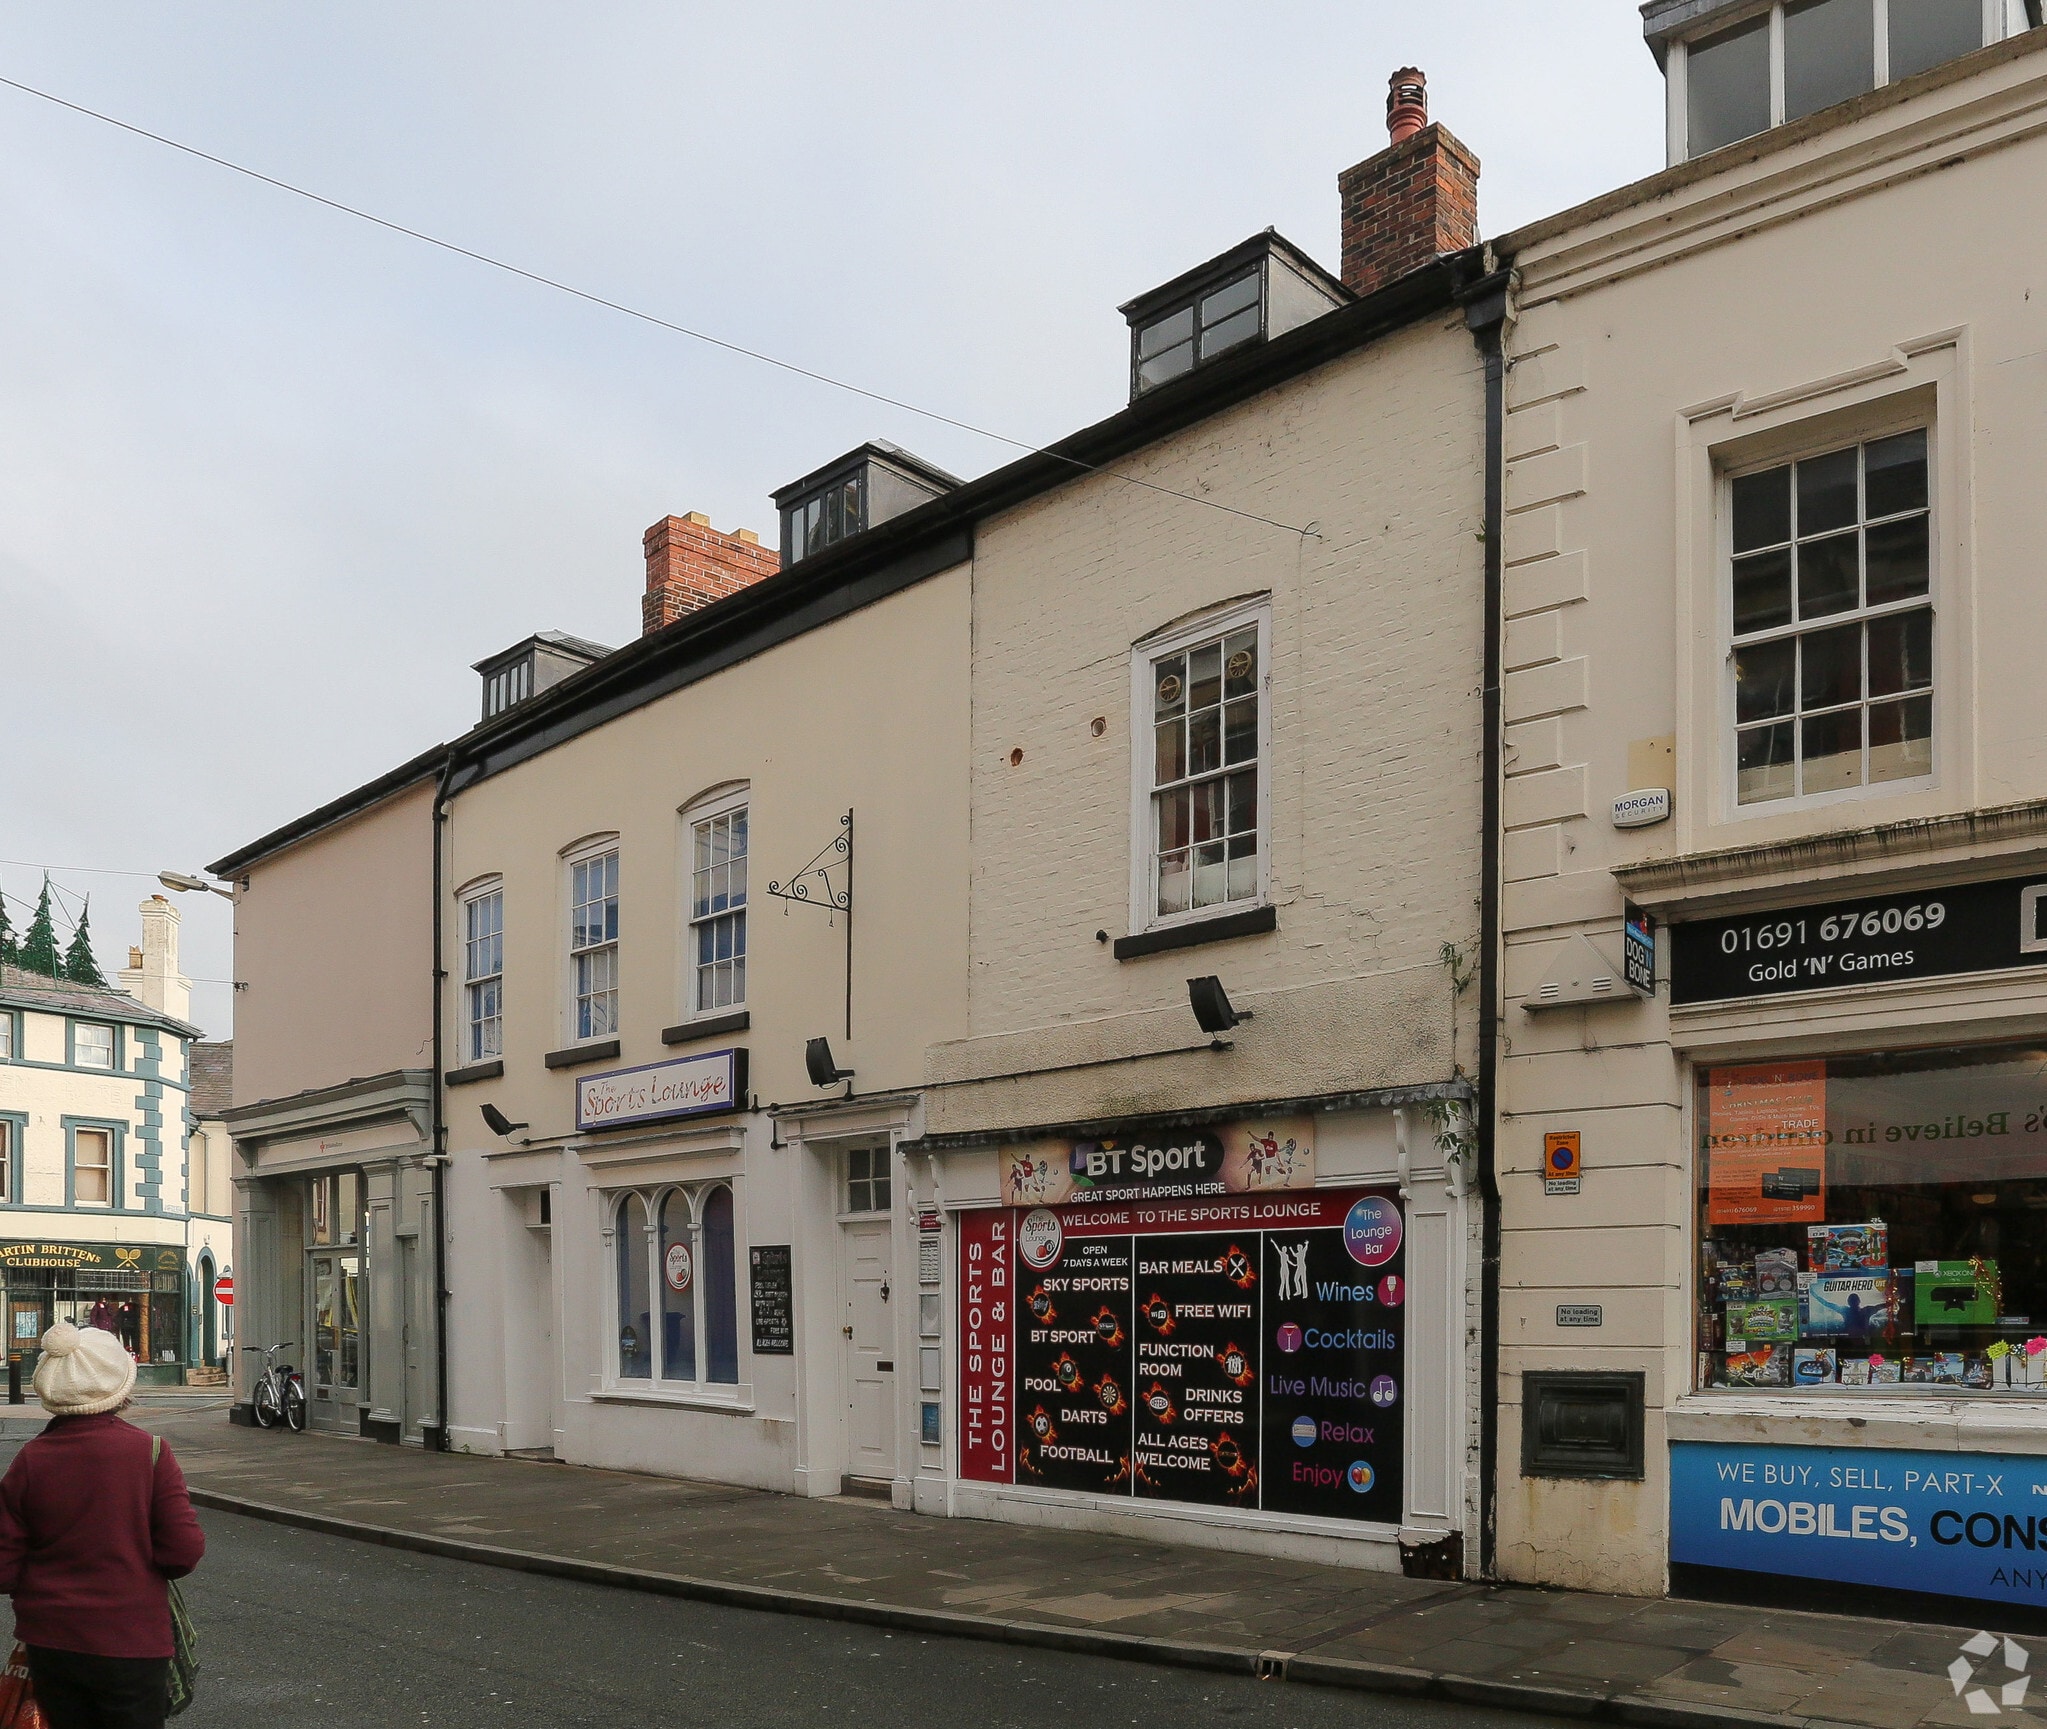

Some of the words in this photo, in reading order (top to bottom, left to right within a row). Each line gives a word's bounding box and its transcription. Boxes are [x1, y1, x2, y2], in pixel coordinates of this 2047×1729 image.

[1614, 795, 1664, 812] MORGAN
[1615, 805, 1664, 819] SECURITY
[1721, 920, 1806, 953] 01691
[1820, 902, 1946, 941] 676069
[1626, 937, 1645, 965] DOG
[1629, 959, 1651, 988] BONE
[1748, 959, 1797, 982] Gold
[1839, 950, 1914, 971] Games
[600, 1081, 616, 1094] The
[584, 1087, 646, 1125] Sports
[651, 1075, 726, 1103] Lounge
[1781, 1119, 1819, 1129] TRADE
[1086, 1150, 1126, 1176] BT
[1131, 1140, 1206, 1177] Sport
[1071, 1189, 1103, 1203] GREAT
[1106, 1187, 1139, 1201] SPORT
[1142, 1184, 1193, 1199] HAPPENS
[1195, 1182, 1226, 1195] HERE
[1062, 1211, 1130, 1226] WELCOME
[1137, 1210, 1155, 1223] TO
[1158, 1209, 1188, 1222] THE
[1190, 1206, 1250, 1221] SPORTS
[1253, 1202, 1321, 1218] LOUNGE
[1362, 1209, 1382, 1221] The
[1025, 1217, 1056, 1235] Sports
[1351, 1226, 1393, 1239] Lounge
[1026, 1233, 1047, 1244] Lounge
[41, 1245, 102, 1263] BRITTENS
[991, 1221, 1006, 1287] BAR
[1082, 1246, 1108, 1255] OPEN
[1365, 1243, 1384, 1255] Bar
[6, 1257, 81, 1268] CLUBHOUSE
[669, 1251, 688, 1265] Sports
[1063, 1259, 1068, 1267] 7
[1070, 1259, 1092, 1267] DAYS
[1093, 1259, 1100, 1267] A
[1101, 1258, 1128, 1267] WEEK
[1139, 1261, 1169, 1274] BAR
[1172, 1260, 1224, 1274] MEALS
[1043, 1278, 1070, 1291] SKY
[1072, 1278, 1129, 1291] SPORTS
[1316, 1282, 1374, 1301] Wines
[1823, 1281, 1851, 1291] GUITAR
[1852, 1280, 1874, 1290] HERO
[968, 1242, 983, 1372] SPORTS
[991, 1301, 1006, 1322] &
[1175, 1304, 1214, 1318] FREE
[1218, 1304, 1251, 1318] WIFI
[1572, 1308, 1598, 1316] loading
[1031, 1330, 1048, 1342] BT
[1050, 1330, 1096, 1343] SPORT
[1304, 1328, 1395, 1349] Cocktails
[1139, 1344, 1214, 1358] FUNCTION
[1139, 1363, 1182, 1376] ROOM
[1025, 1378, 1061, 1391] POOL
[1270, 1375, 1306, 1395] Live
[1311, 1376, 1366, 1398] Music
[991, 1334, 1006, 1471] LOUNGE
[1186, 1388, 1243, 1403] DRINKS
[968, 1386, 983, 1449] THE
[1061, 1409, 1107, 1424] DARTS
[1183, 1408, 1244, 1423] OFFERS
[1321, 1421, 1375, 1443] Relax
[1137, 1433, 1165, 1447] ALL
[1168, 1435, 1208, 1450] AGES
[1040, 1445, 1114, 1463] FOOTBALL
[1135, 1452, 1211, 1471] WELCOME
[1292, 1462, 1344, 1488] Enjoy
[1717, 1462, 1755, 1483] WE
[1764, 1464, 1819, 1488] BUY,
[1829, 1467, 1893, 1492] SELL,
[1905, 1470, 2003, 1496] PART-X
[1720, 1497, 1917, 1547] MOBILES,
[1989, 1566, 2047, 1590] ANY
